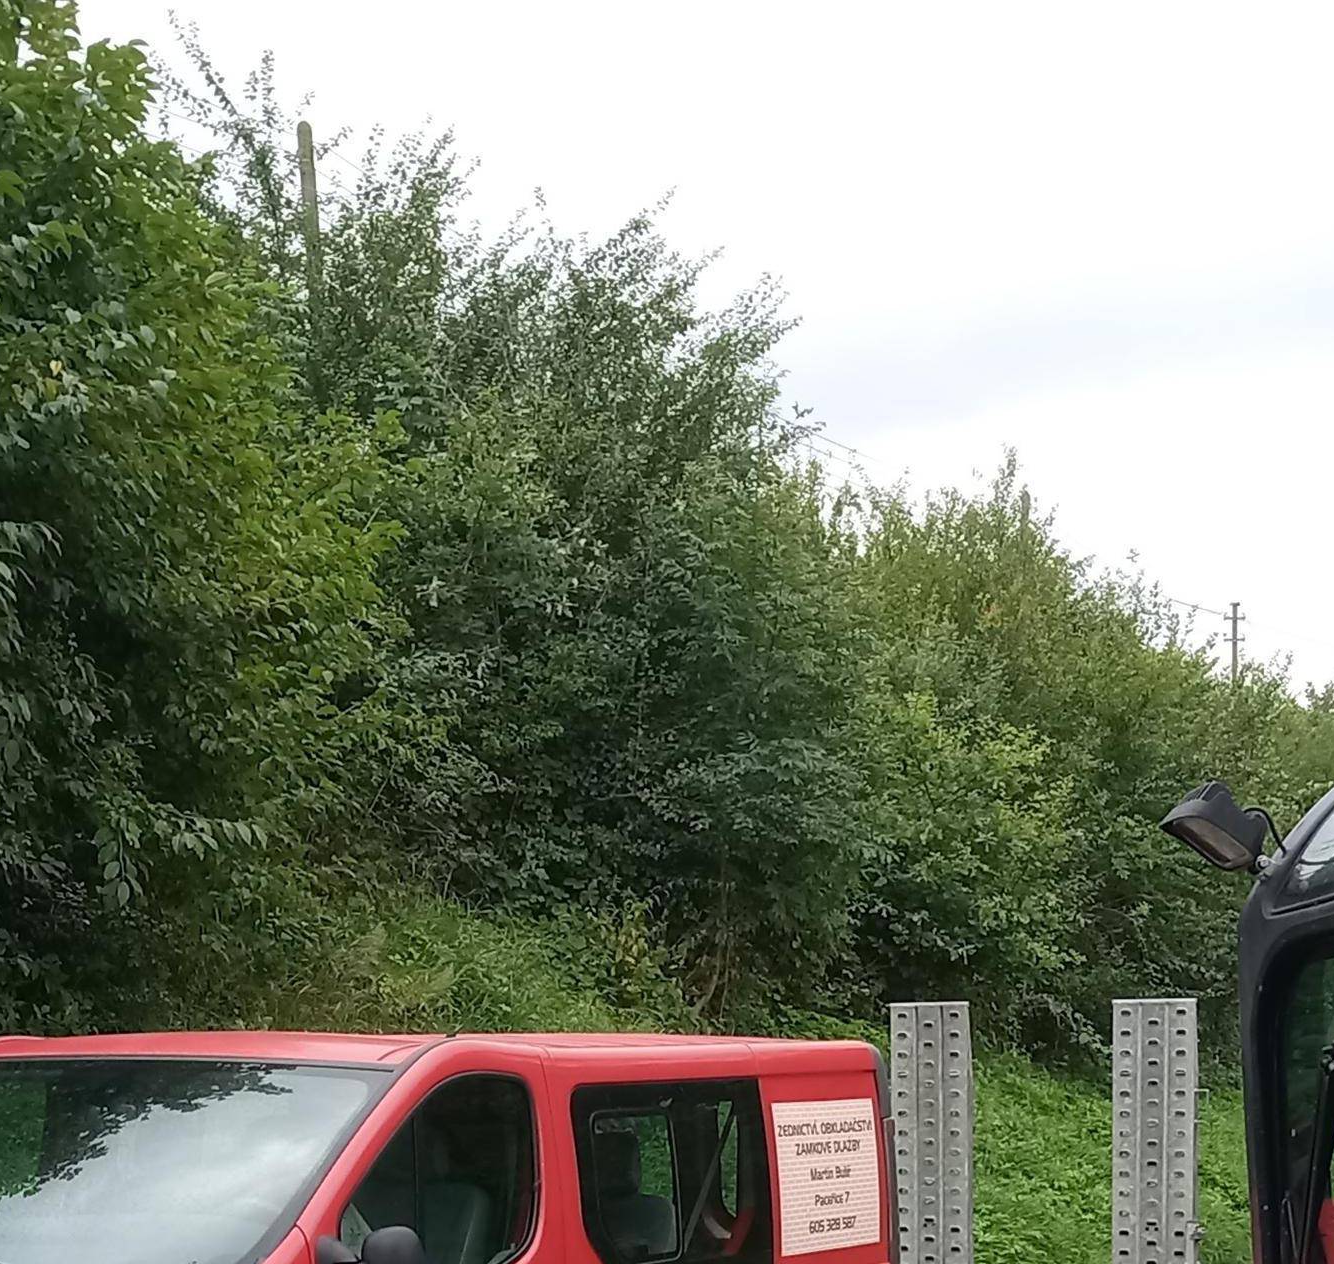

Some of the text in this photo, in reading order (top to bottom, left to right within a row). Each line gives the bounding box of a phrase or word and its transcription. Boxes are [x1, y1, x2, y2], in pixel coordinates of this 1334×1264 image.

[810, 1167, 833, 1181] Martin
[844, 1190, 850, 1203] 7
[809, 1219, 825, 1234] 605
[826, 1217, 841, 1232] 328
